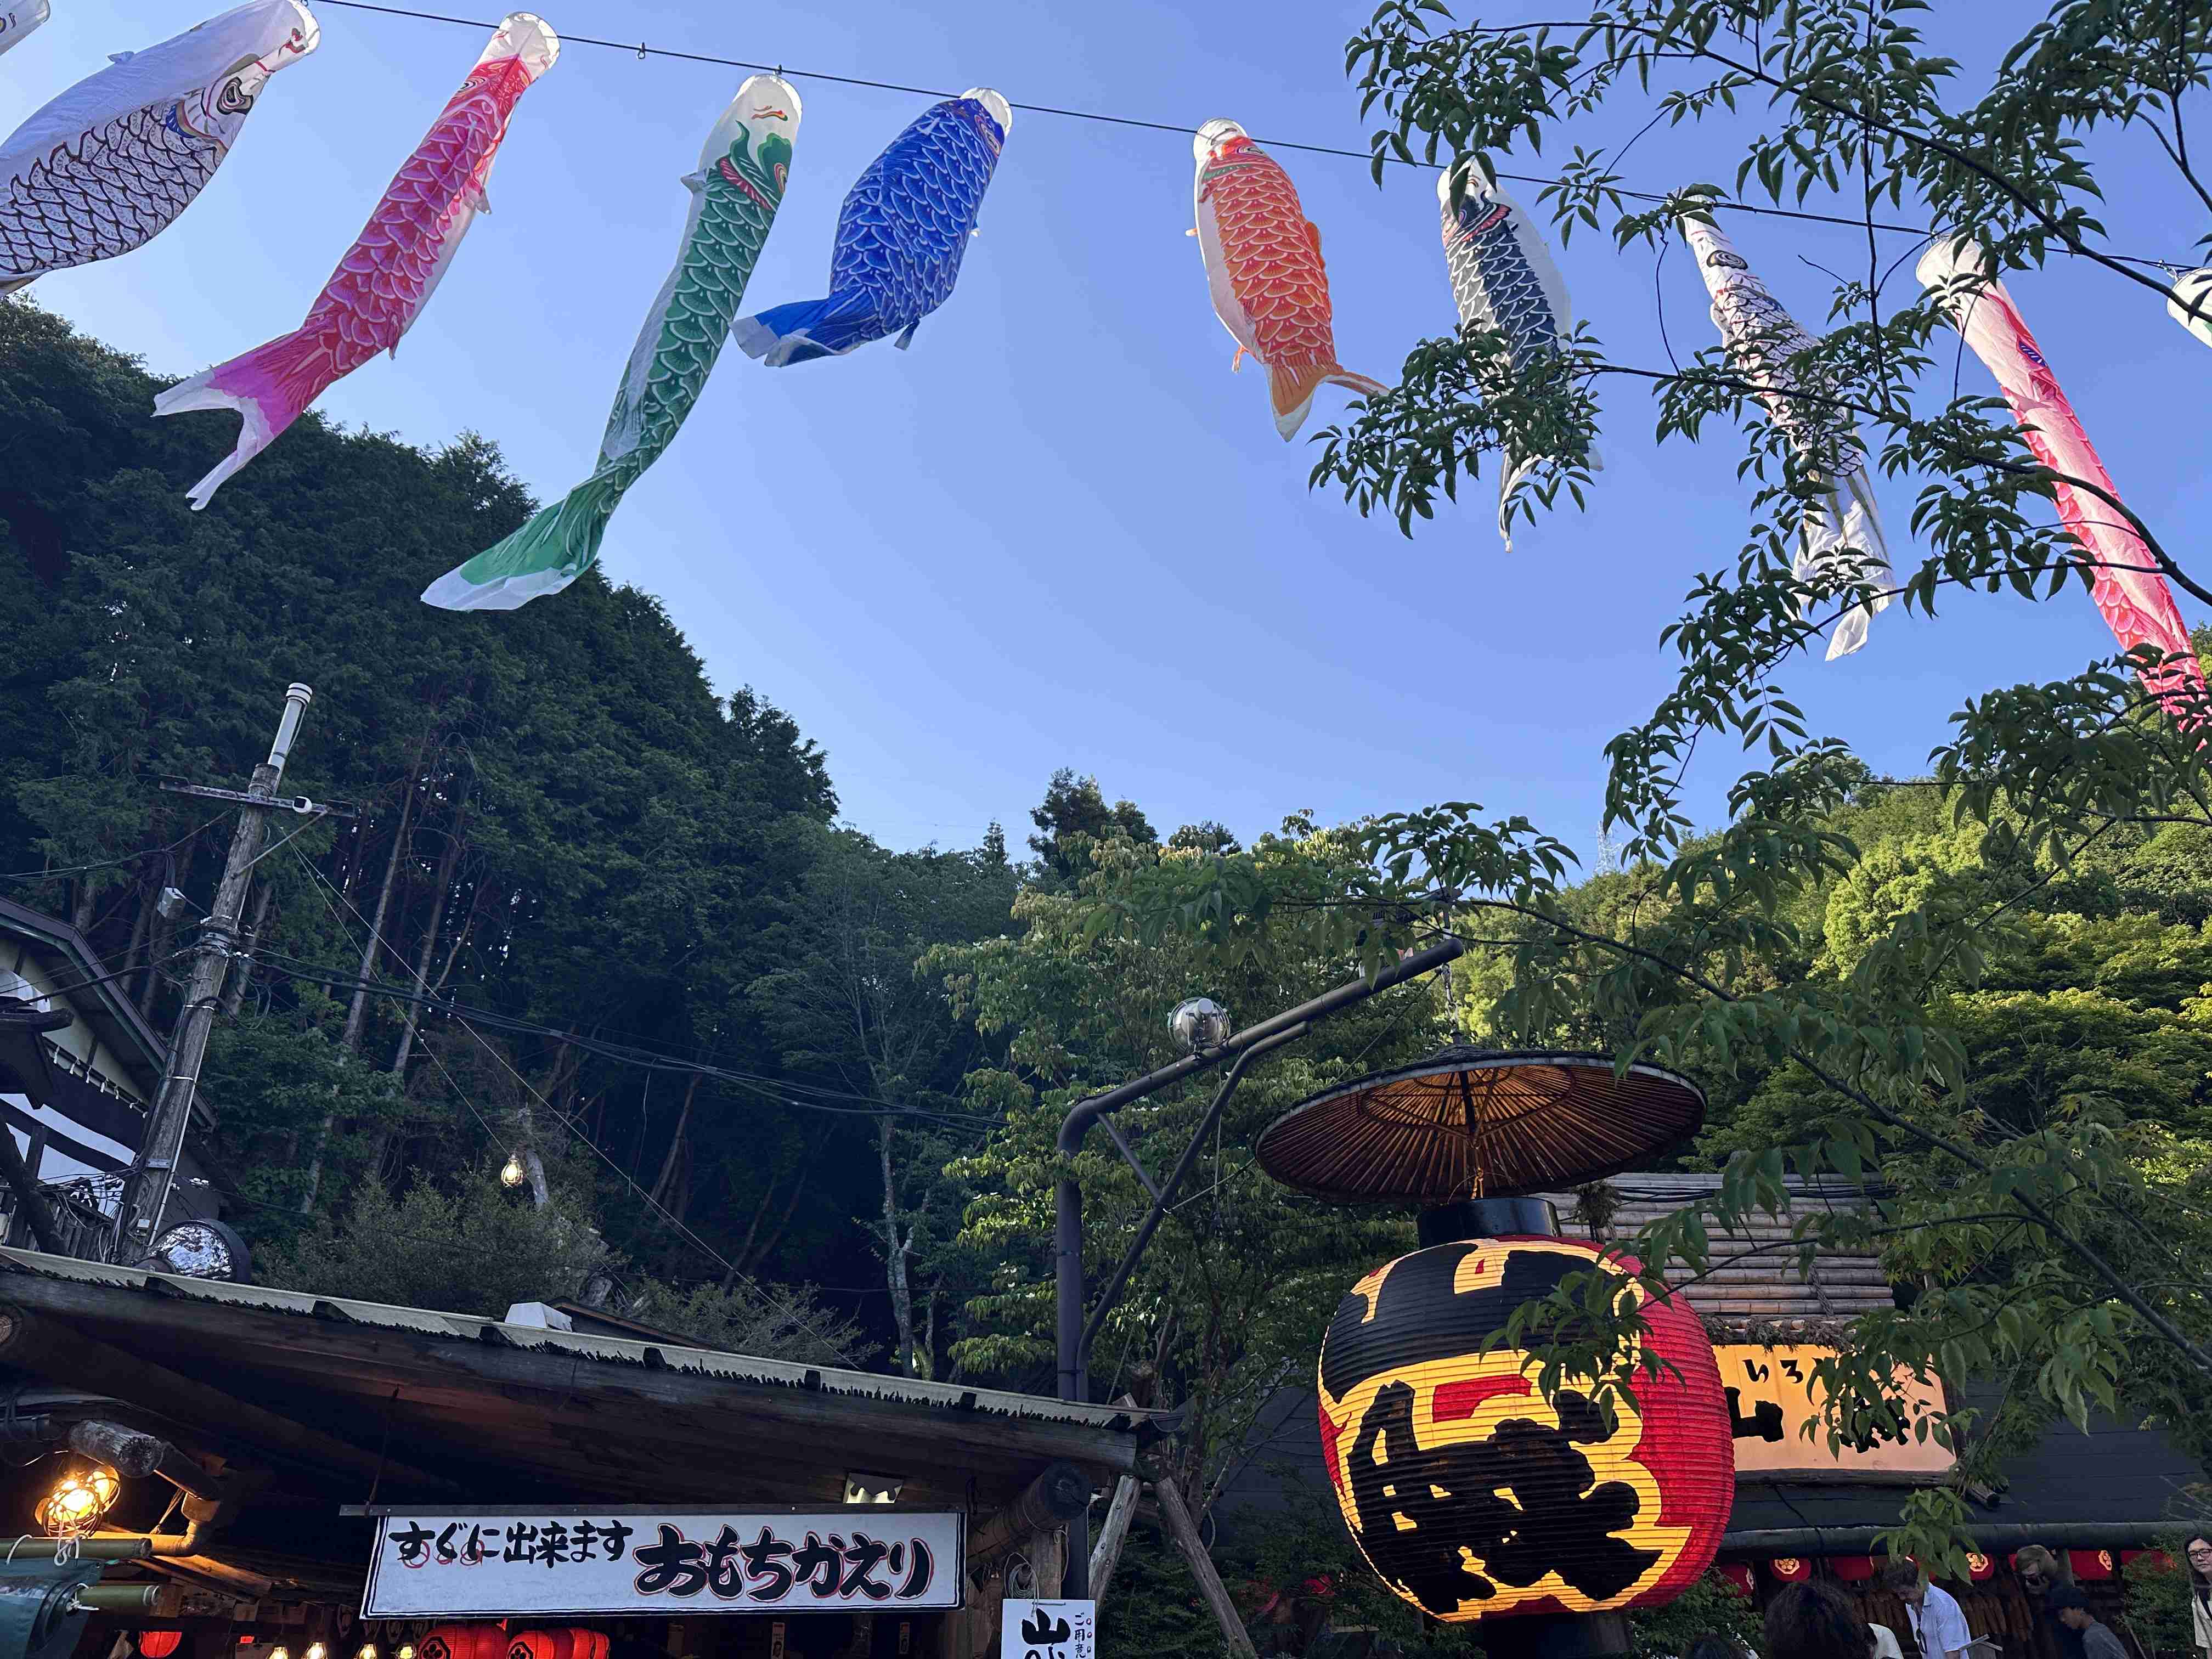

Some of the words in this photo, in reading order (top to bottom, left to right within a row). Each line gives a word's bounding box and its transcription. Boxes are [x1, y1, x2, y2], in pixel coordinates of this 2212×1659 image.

[1318, 1241, 1671, 1617] 山賊
[388, 1520, 633, 1568] すぐに出来ます
[633, 1523, 934, 1602] おもちかえり
[1022, 1608, 1070, 1659] 山
